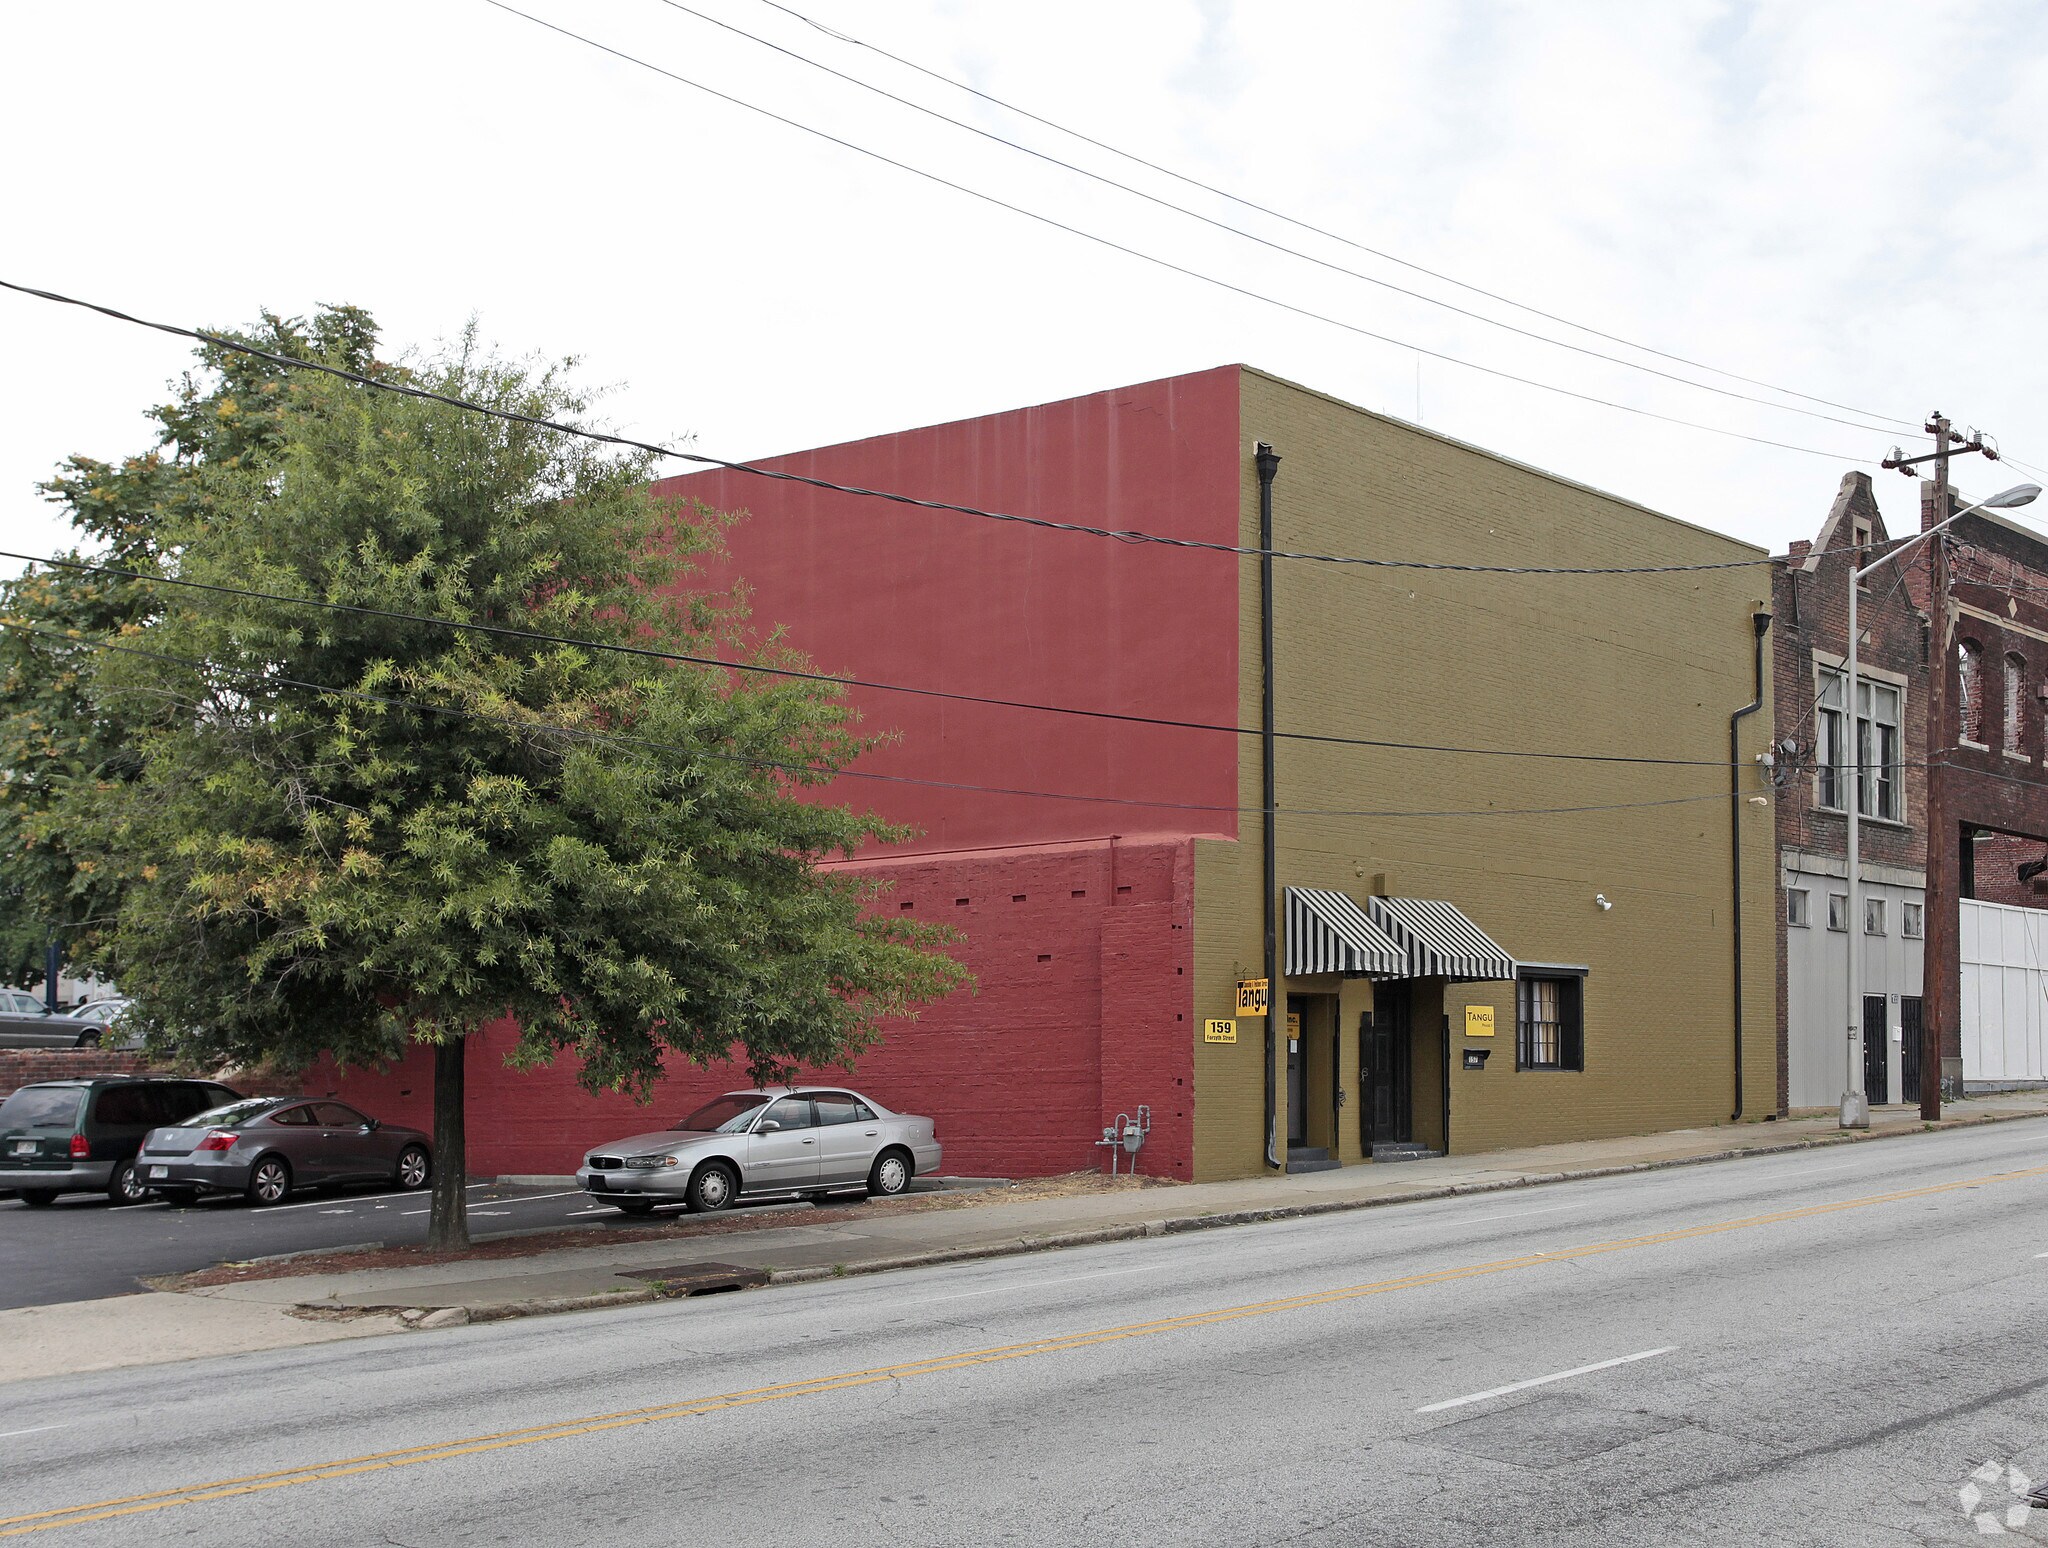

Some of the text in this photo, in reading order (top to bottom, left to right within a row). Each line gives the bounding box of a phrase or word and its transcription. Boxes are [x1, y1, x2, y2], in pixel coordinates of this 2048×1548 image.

[1237, 982, 1267, 1012] Tangu
[1467, 1012, 1493, 1021] TANGU
[1210, 1022, 1231, 1033] 159
